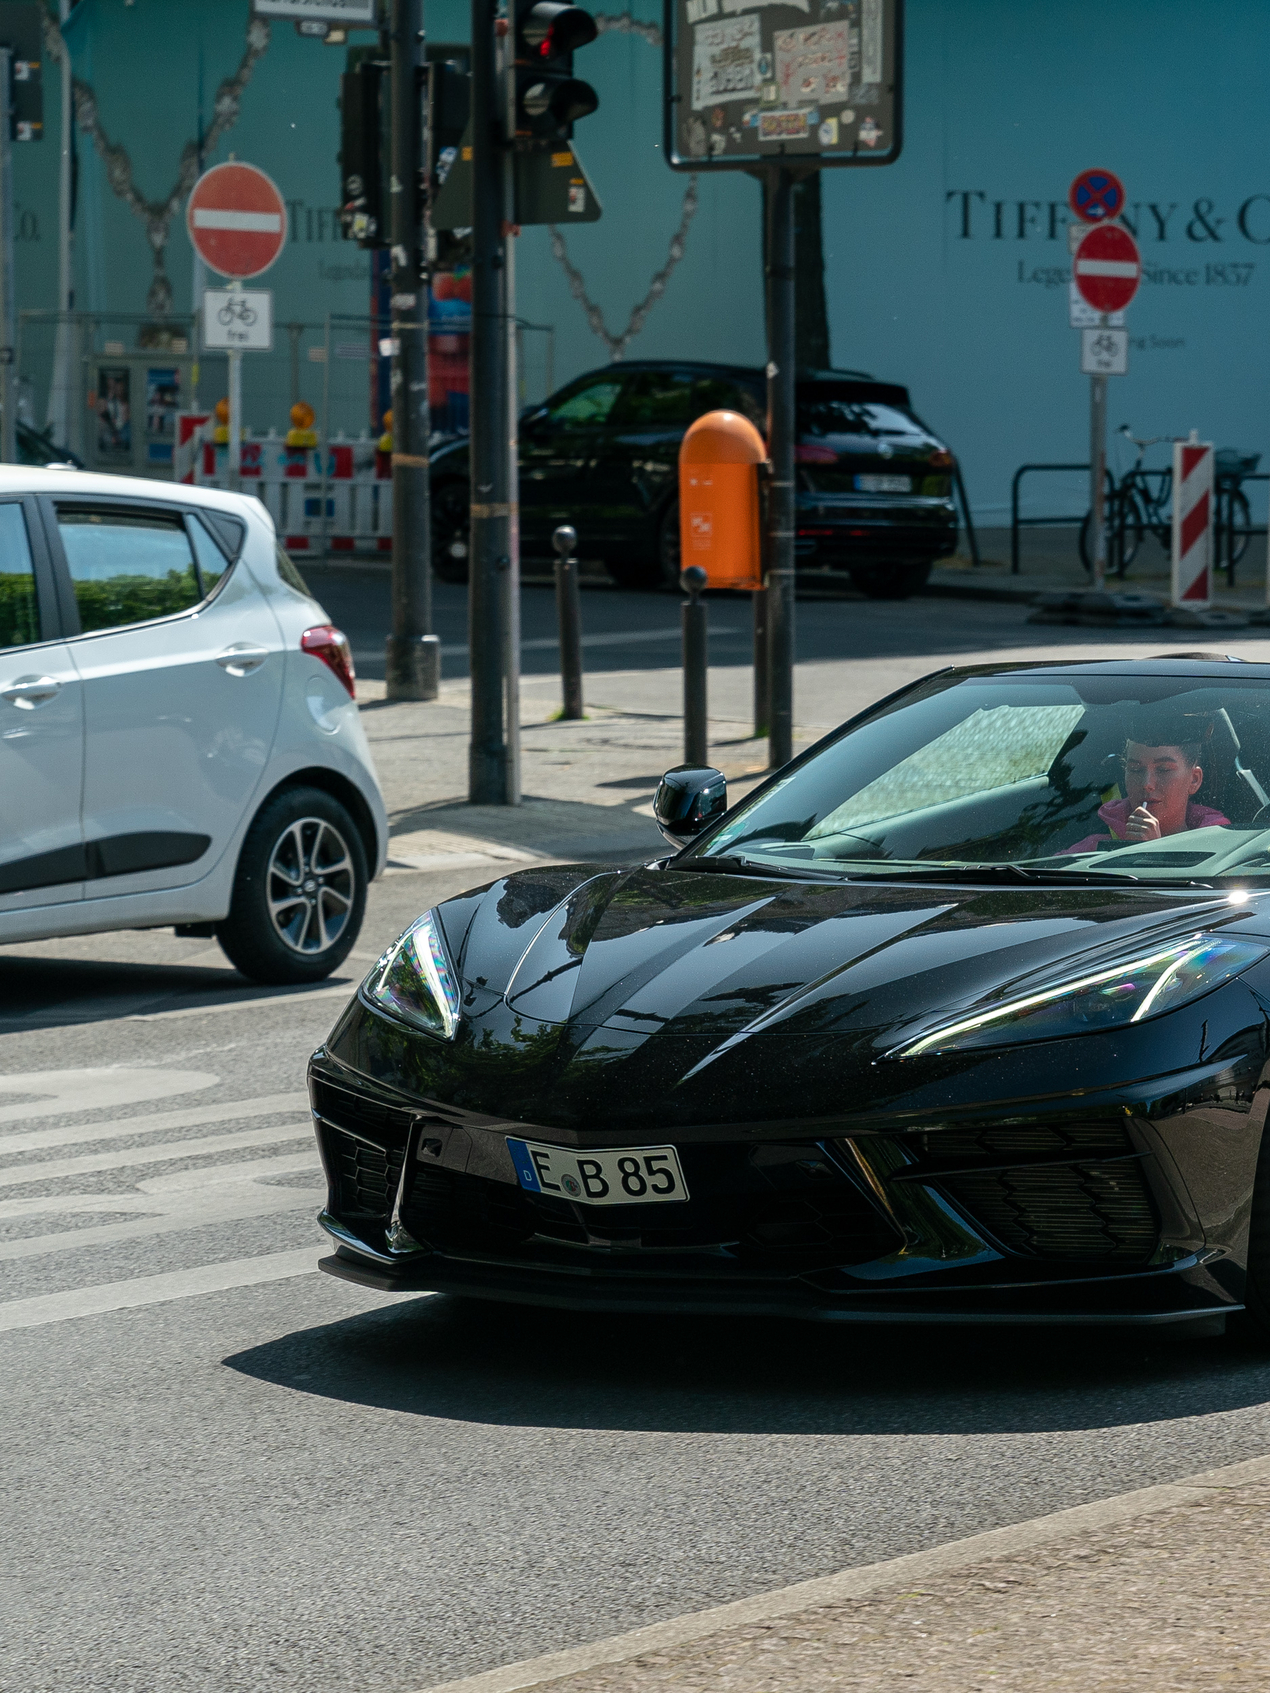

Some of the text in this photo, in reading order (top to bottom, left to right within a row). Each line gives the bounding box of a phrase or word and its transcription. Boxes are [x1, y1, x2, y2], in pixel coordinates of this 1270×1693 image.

[945, 190, 1178, 241] TIFFNY
[1186, 198, 1225, 243] &
[227, 328, 250, 342] frei
[530, 1150, 561, 1192] E
[576, 1159, 610, 1198] B
[617, 1155, 676, 1197] 85
